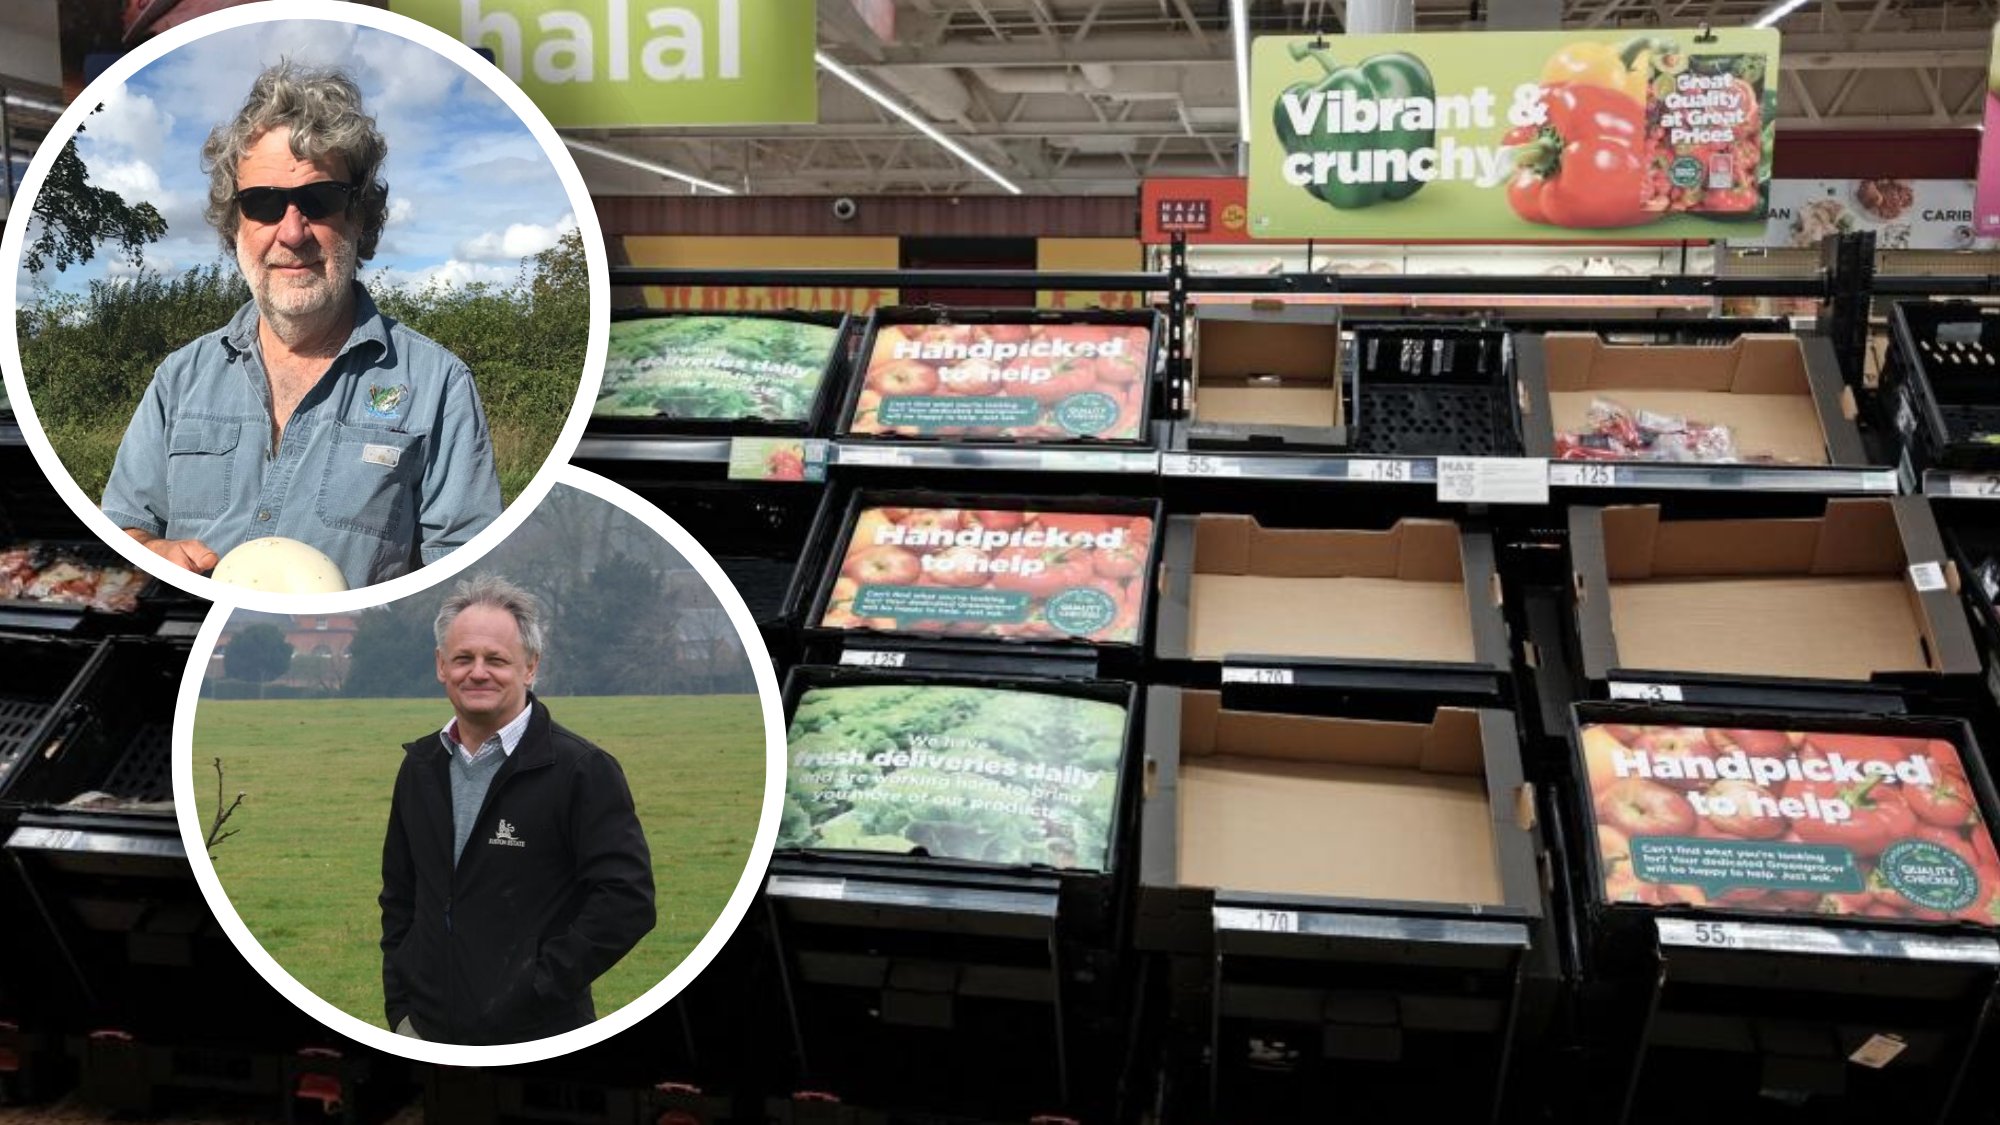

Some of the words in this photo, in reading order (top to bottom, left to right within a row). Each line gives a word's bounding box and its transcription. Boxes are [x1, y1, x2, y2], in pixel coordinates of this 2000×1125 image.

[460, 0, 741, 83] halal
[1677, 73, 1733, 91] Great
[1665, 90, 1742, 109] Quality
[1282, 86, 1496, 136] Vibrant
[1507, 83, 1550, 126] &
[1660, 111, 1683, 127] at
[1687, 108, 1744, 126] Great
[1671, 127, 1735, 144] Prices
[1282, 137, 1515, 188] crunchy
[1162, 202, 1204, 211] HAJI
[1162, 213, 1205, 222] BABA
[893, 337, 1124, 360] Handpicked
[937, 366, 969, 383] to
[982, 366, 1052, 384] help
[873, 526, 1124, 550] Handpicked
[920, 554, 956, 573] to
[969, 555, 1046, 576] help
[908, 733, 939, 748] We
[794, 748, 866, 768] fresh
[872, 748, 1019, 777] deliveries
[1024, 762, 1103, 790] daily
[1611, 750, 1933, 785] Handpicked
[811, 789, 848, 803] you
[931, 794, 966, 807] our
[1686, 790, 1738, 816] to
[1748, 790, 1852, 824] help
[1703, 847, 1733, 857] what
[1901, 864, 1955, 878] QUALITY
[1903, 874, 1959, 887] CHECKED
[1695, 923, 1737, 947] 55p
